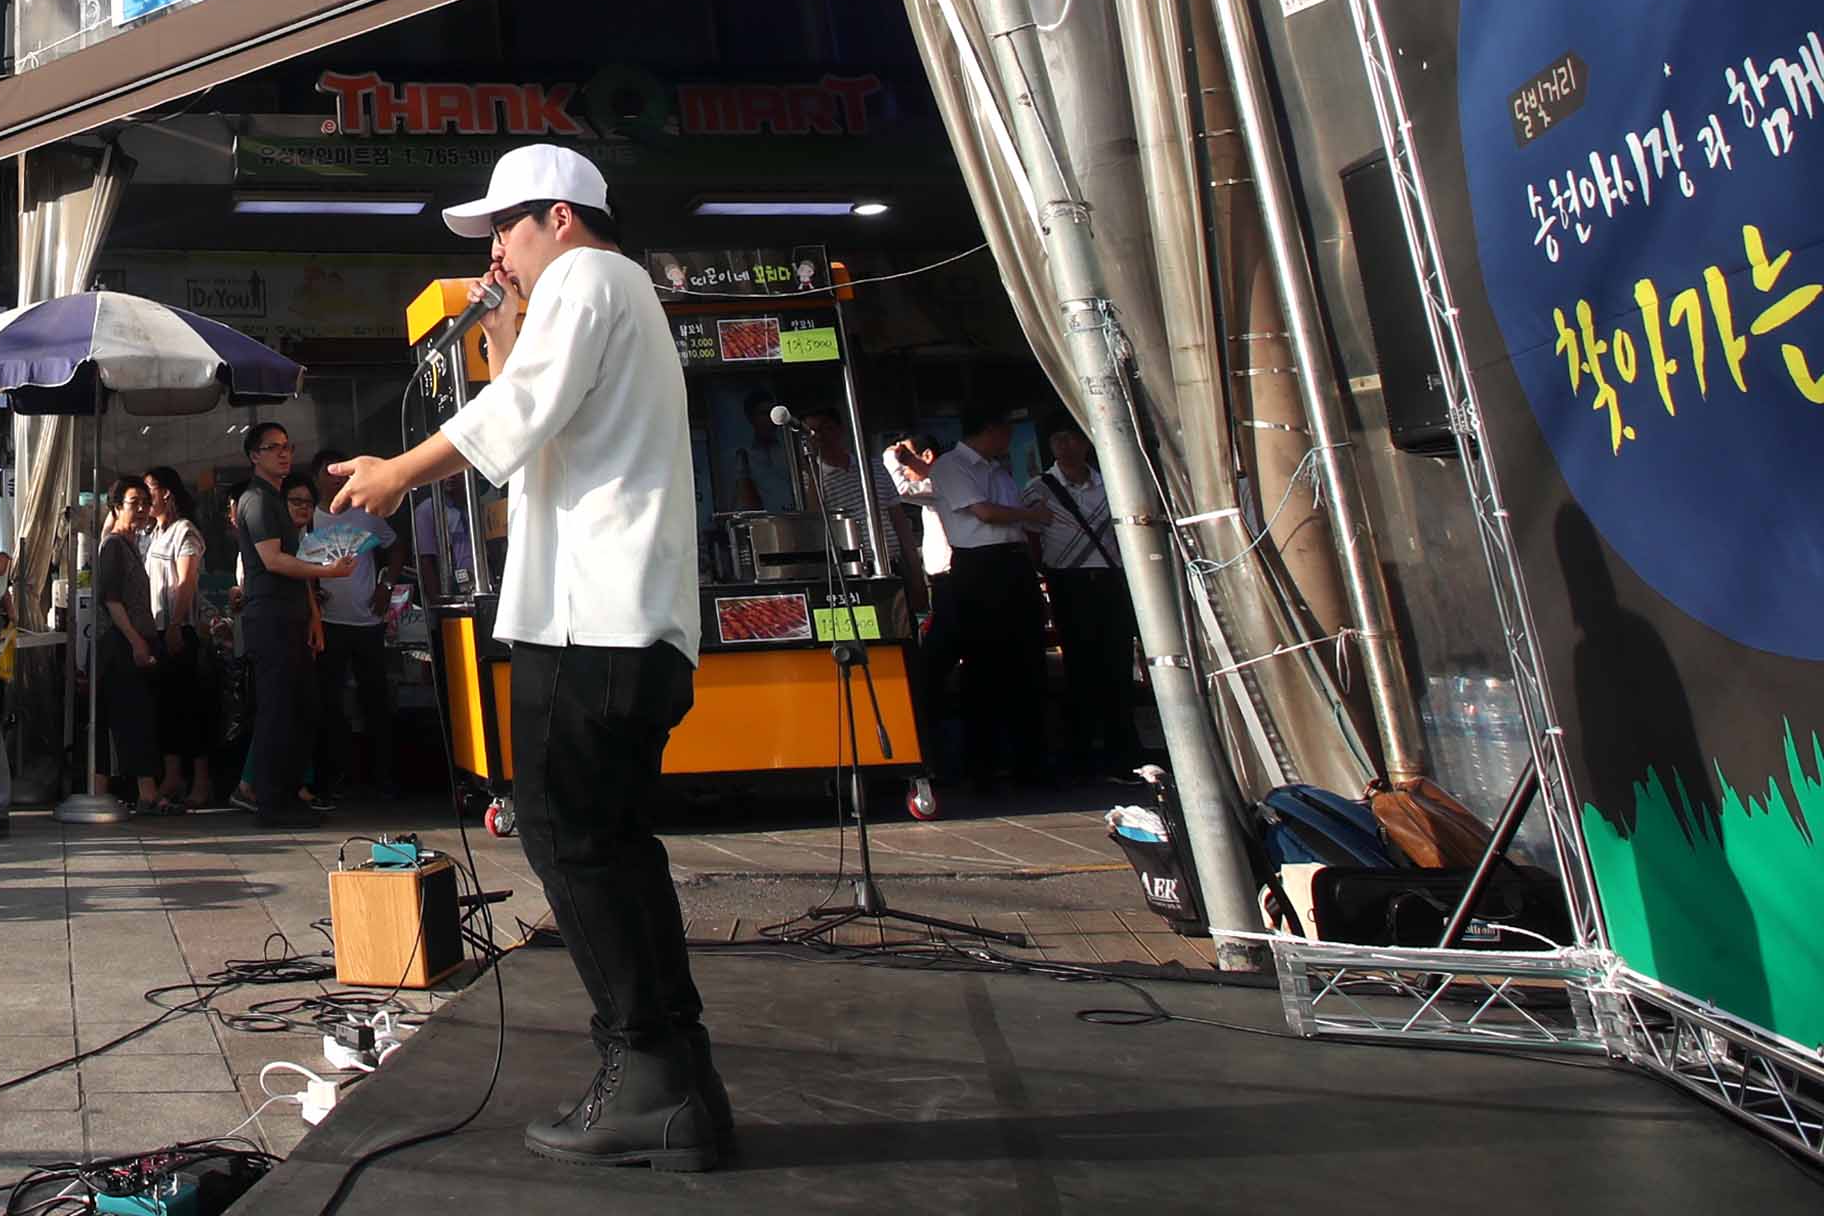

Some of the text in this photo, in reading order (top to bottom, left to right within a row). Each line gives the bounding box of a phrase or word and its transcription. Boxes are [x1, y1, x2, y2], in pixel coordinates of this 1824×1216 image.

[315, 70, 584, 139] THANK
[677, 72, 881, 137] MART
[1514, 57, 1577, 140] 달빛거리
